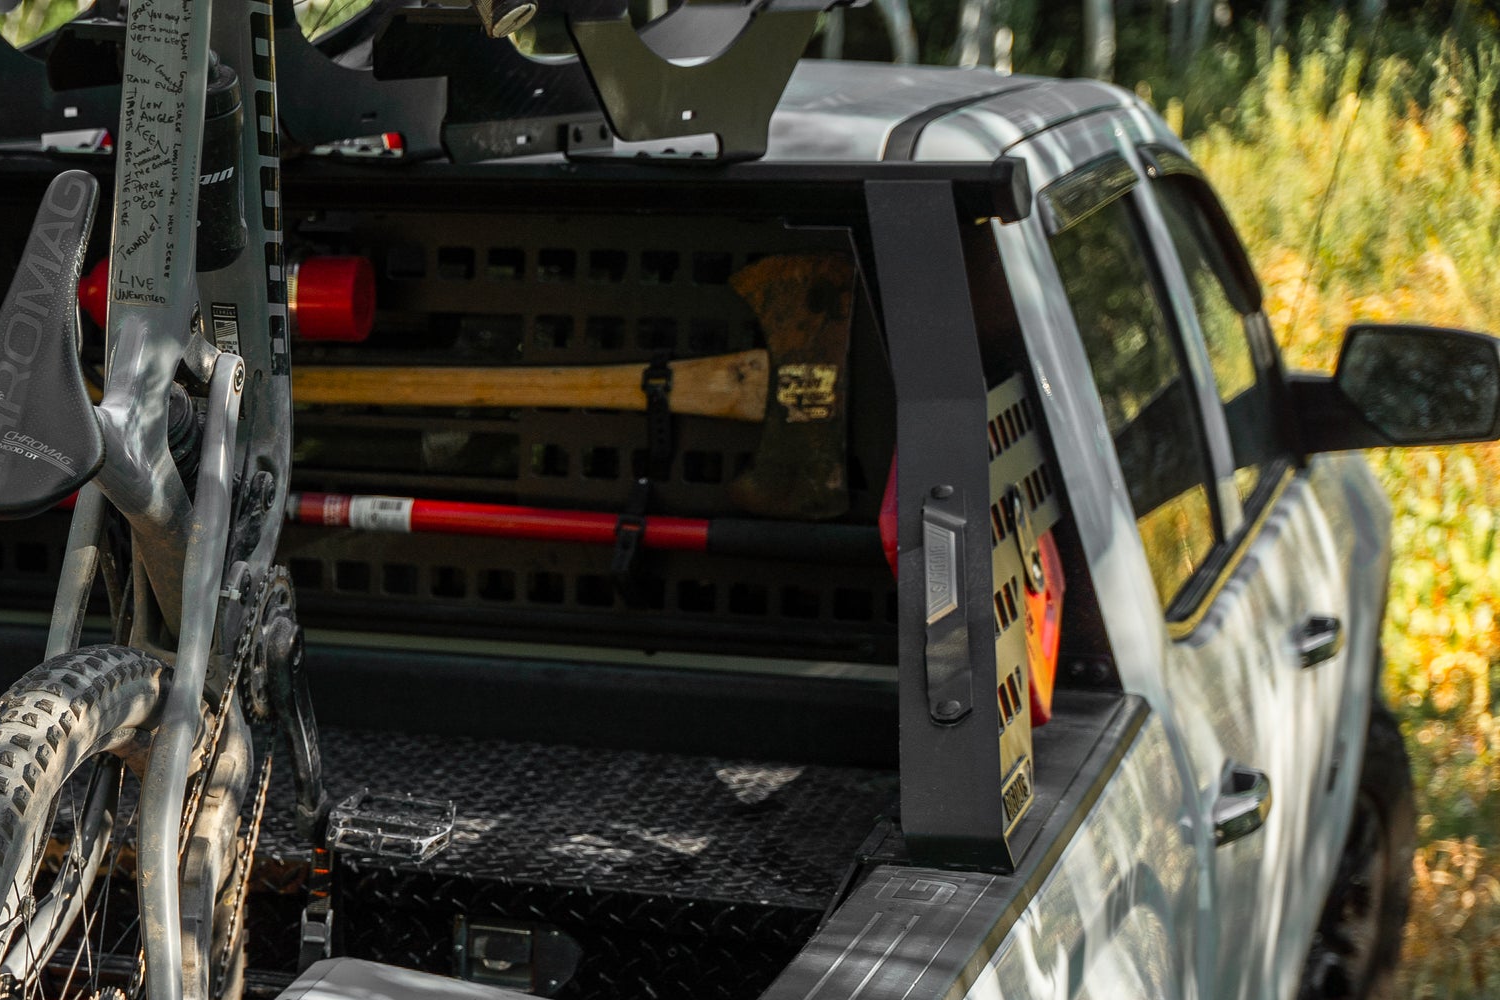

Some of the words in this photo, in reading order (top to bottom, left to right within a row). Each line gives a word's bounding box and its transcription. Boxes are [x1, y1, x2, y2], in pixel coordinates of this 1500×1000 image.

[131, 48, 156, 66] JUST
[140, 110, 174, 124] ANGLE
[134, 122, 170, 154] KEEN
[140, 200, 156, 210] GO
[118, 270, 154, 290] LIVE
[4, 430, 74, 464] CHROMAG
[25, 452, 40, 460] DT
